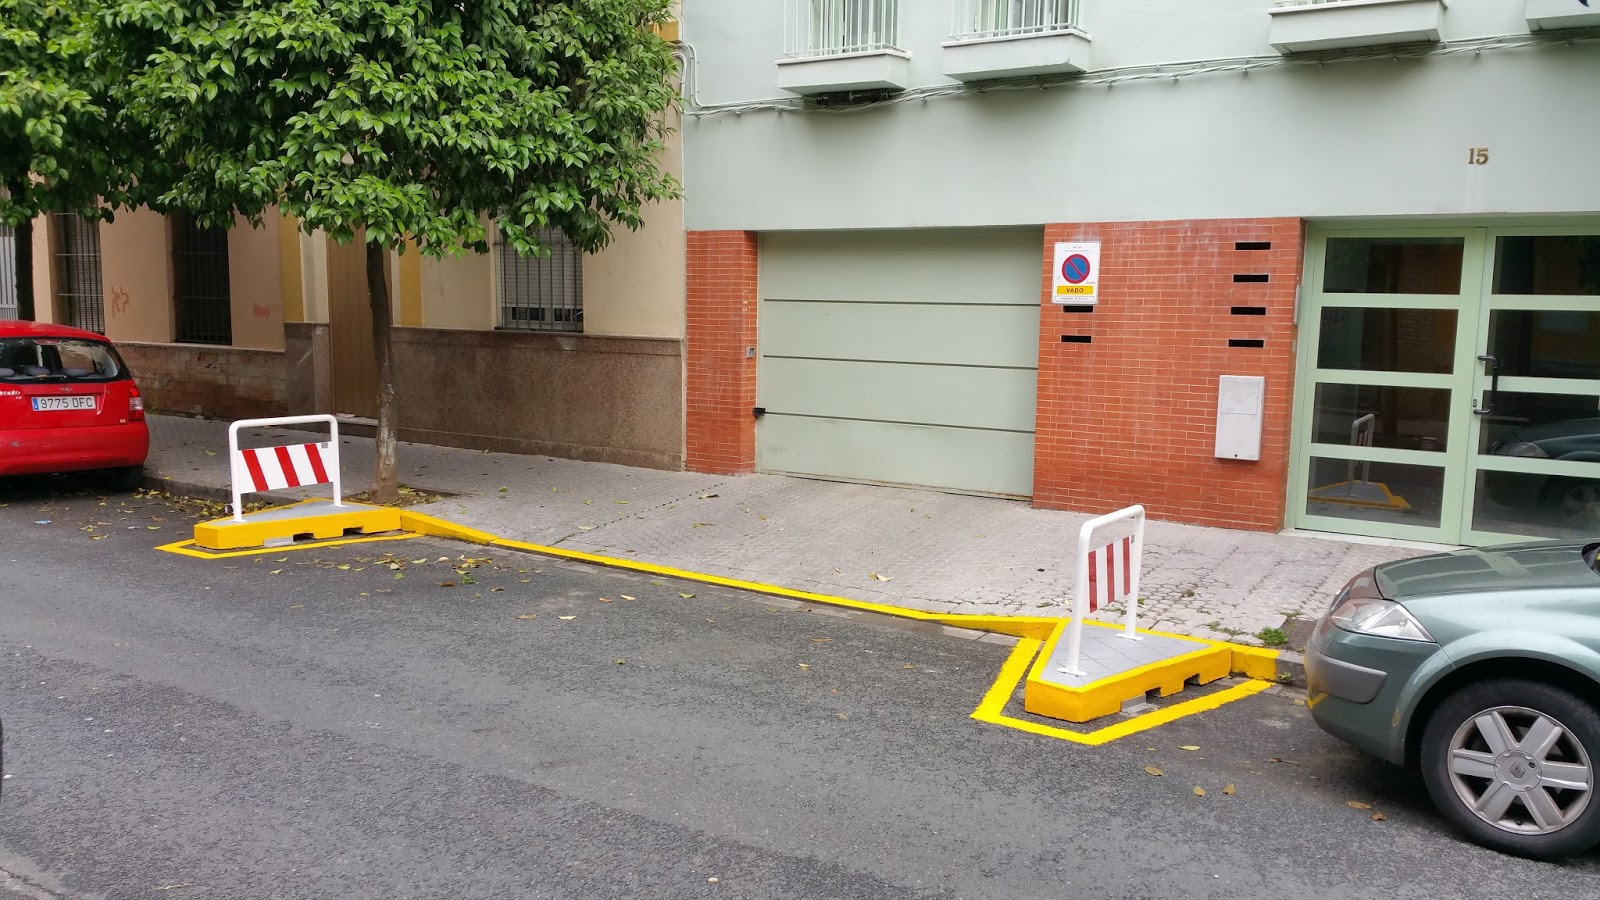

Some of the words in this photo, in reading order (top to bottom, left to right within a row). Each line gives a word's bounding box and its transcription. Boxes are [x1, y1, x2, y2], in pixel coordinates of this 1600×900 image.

[1468, 147, 1489, 165] 15
[40, 398, 69, 409] 9775
[72, 397, 93, 408] DFC
